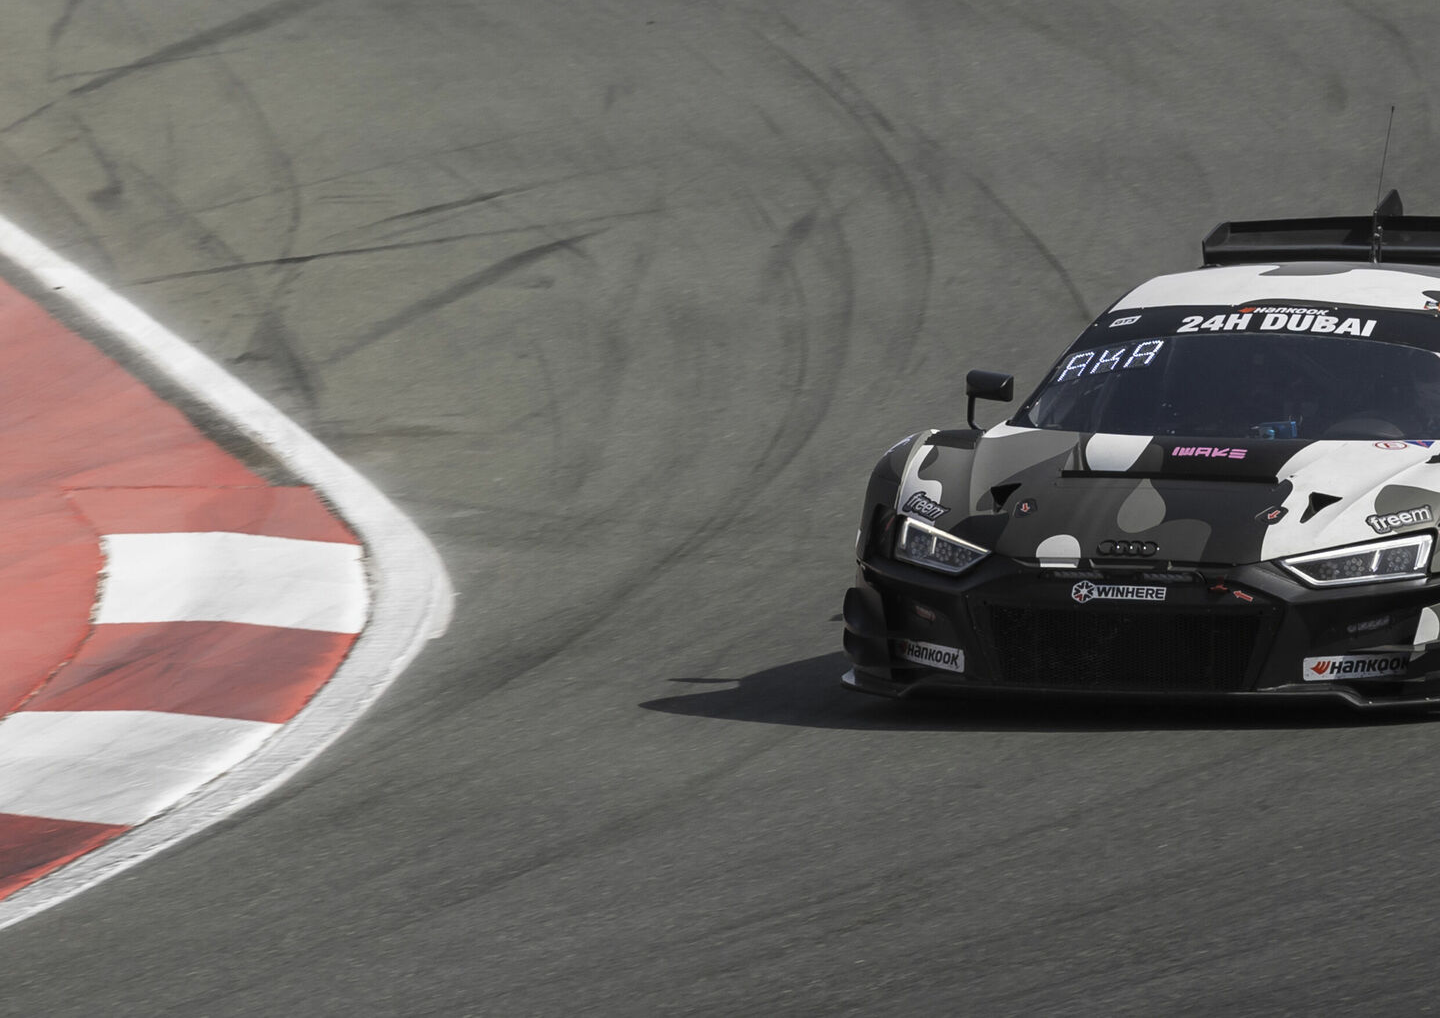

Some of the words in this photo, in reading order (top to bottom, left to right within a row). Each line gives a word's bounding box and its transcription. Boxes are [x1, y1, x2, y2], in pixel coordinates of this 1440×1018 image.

[1177, 313, 1253, 333] 24H
[1260, 313, 1377, 337] DUBAI
[1057, 340, 1164, 382] AKA
[1372, 505, 1431, 531] freem
[1097, 587, 1166, 600] WINHERE
